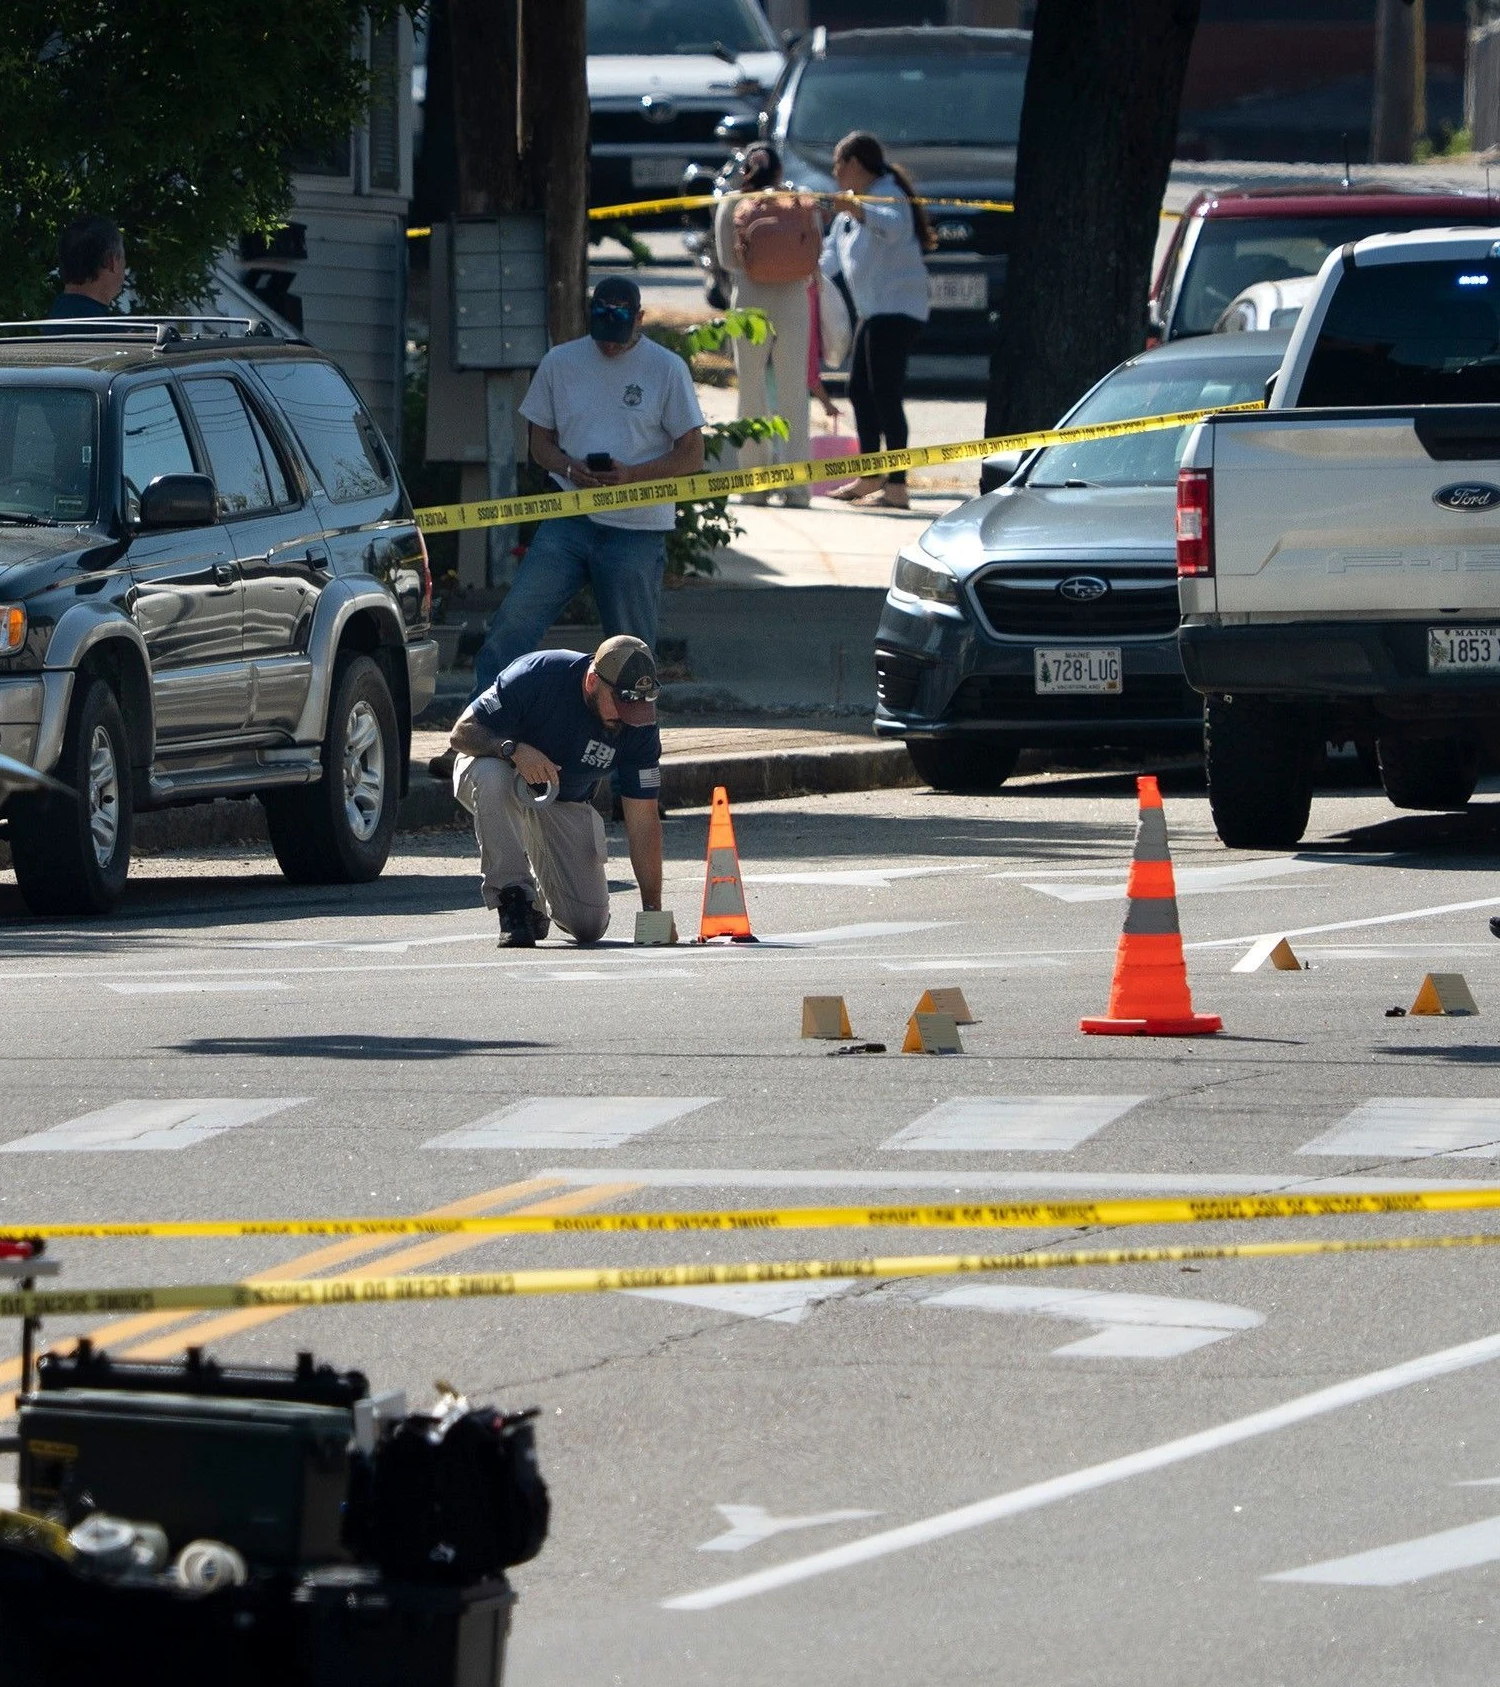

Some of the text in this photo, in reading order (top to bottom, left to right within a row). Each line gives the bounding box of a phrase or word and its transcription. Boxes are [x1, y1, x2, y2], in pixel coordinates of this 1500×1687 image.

[825, 452, 911, 476] POLICE LINE DO NOT CROSS
[708, 468, 795, 492] POLICE LINE DO NOT CROSS
[592, 484, 678, 507] POLICE LINE DO NOT CROSS
[1450, 488, 1492, 505] Ford
[477, 498, 562, 521] POLICE LINE DO NOT CROSS
[1455, 629, 1497, 637] MAINE
[1448, 638, 1491, 664] 1853
[584, 739, 617, 761] FBI
